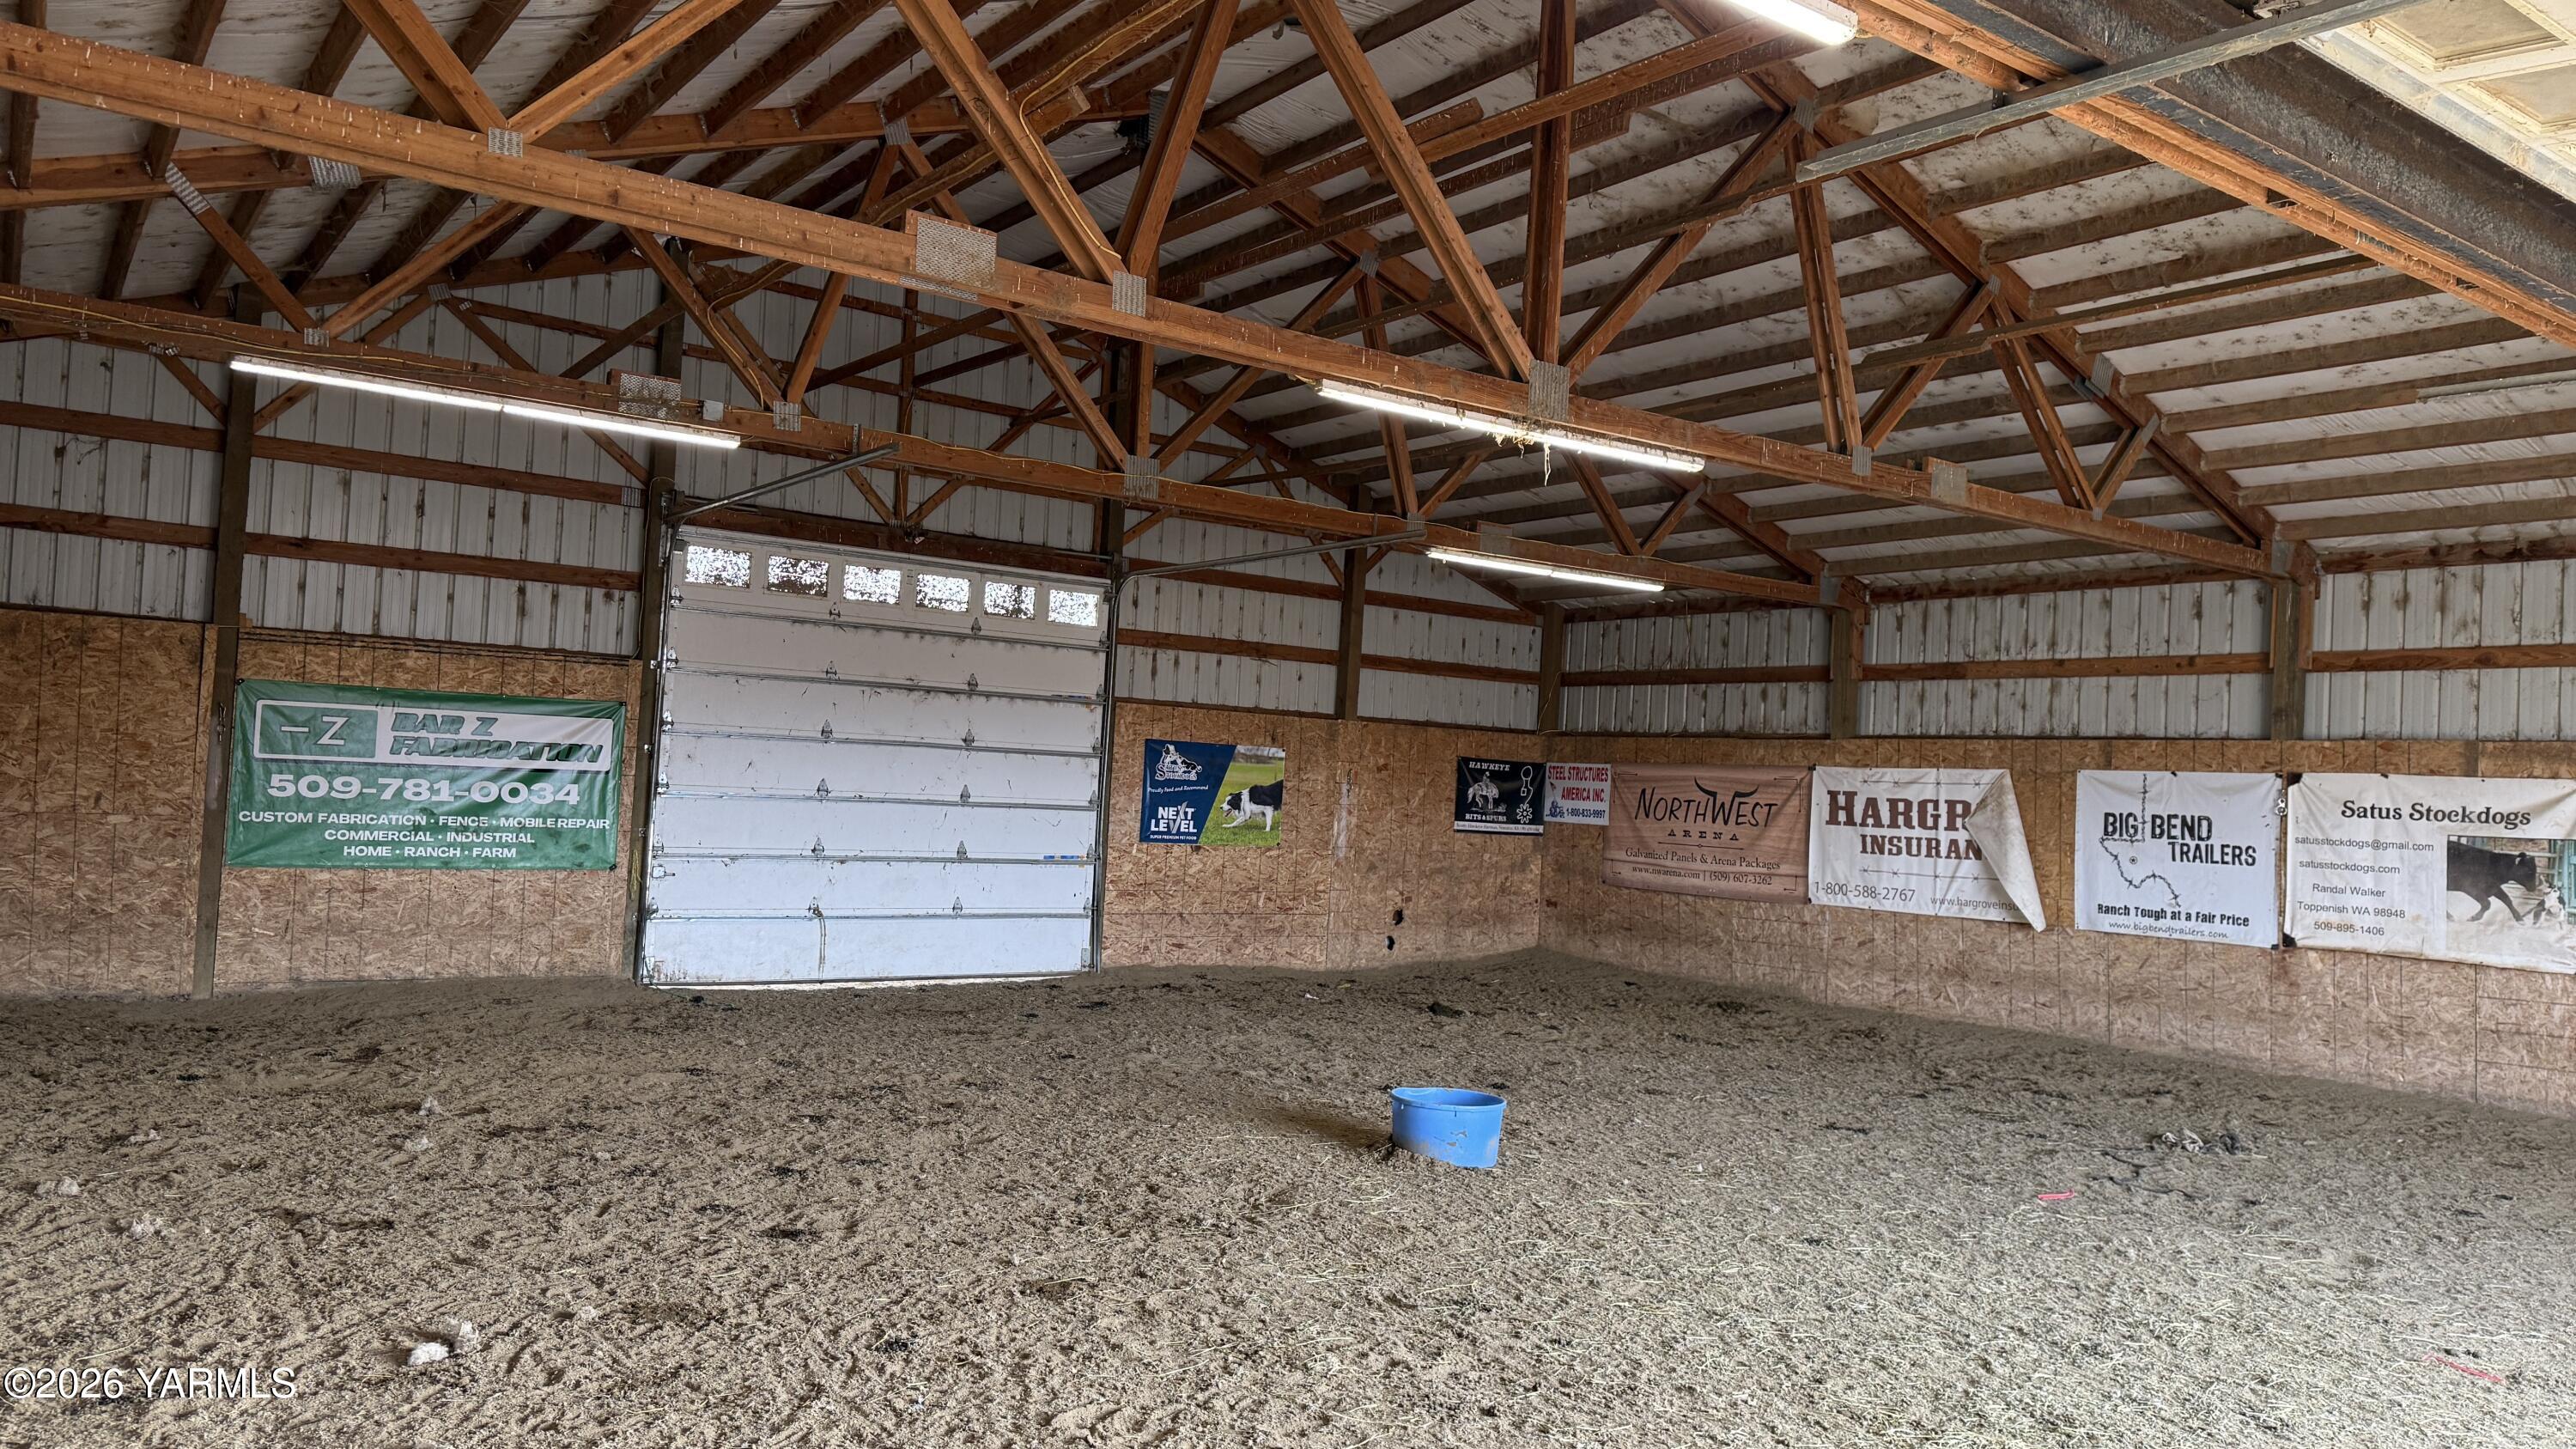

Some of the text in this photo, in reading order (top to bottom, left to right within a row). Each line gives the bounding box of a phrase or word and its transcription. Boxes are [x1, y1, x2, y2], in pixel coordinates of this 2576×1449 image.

[390, 712, 498, 736] BAR Z
[390, 735, 603, 764] FABRICATION
[1469, 761, 1510, 771] HAWKEYE
[1547, 765, 1608, 782] STEEL STRUCTURES
[267, 774, 580, 806] 509-781-0034
[1561, 787, 1606, 802] AMERICA INC.
[1157, 801, 1195, 820] NEXT
[2341, 800, 2531, 830] Satus Stockdogs
[239, 811, 610, 830] CUSTOM FABRICATION FENCE MOBILE REPAIR
[1151, 819, 1197, 833] LEVEL
[2104, 812, 2213, 842] BIG BEND
[325, 830, 535, 843] COMMERCIAL INDUSTRIAL
[2294, 835, 2434, 852] satusstockdogs@gmail.com
[343, 845, 517, 858] HOME RANCH FARM
[1625, 847, 1780, 870] Galvanized Panels & Arena Packages
[2167, 841, 2257, 867] TRAILERS
[1632, 866, 1772, 886] www.nwarena.com (509) 607-3262
[2299, 859, 2400, 874] satusstockdogs.com
[1814, 881, 1916, 902] 1-800-588-2767
[2312, 883, 2386, 898] Randal Walker
[2097, 903, 2250, 927] Ranch Tough at a Fair Price
[2297, 900, 2406, 919] Toppenish WA 98948
[2109, 920, 2229, 939] www.bigbendtrailers.com
[2313, 921, 2385, 936] 509-895-1406
